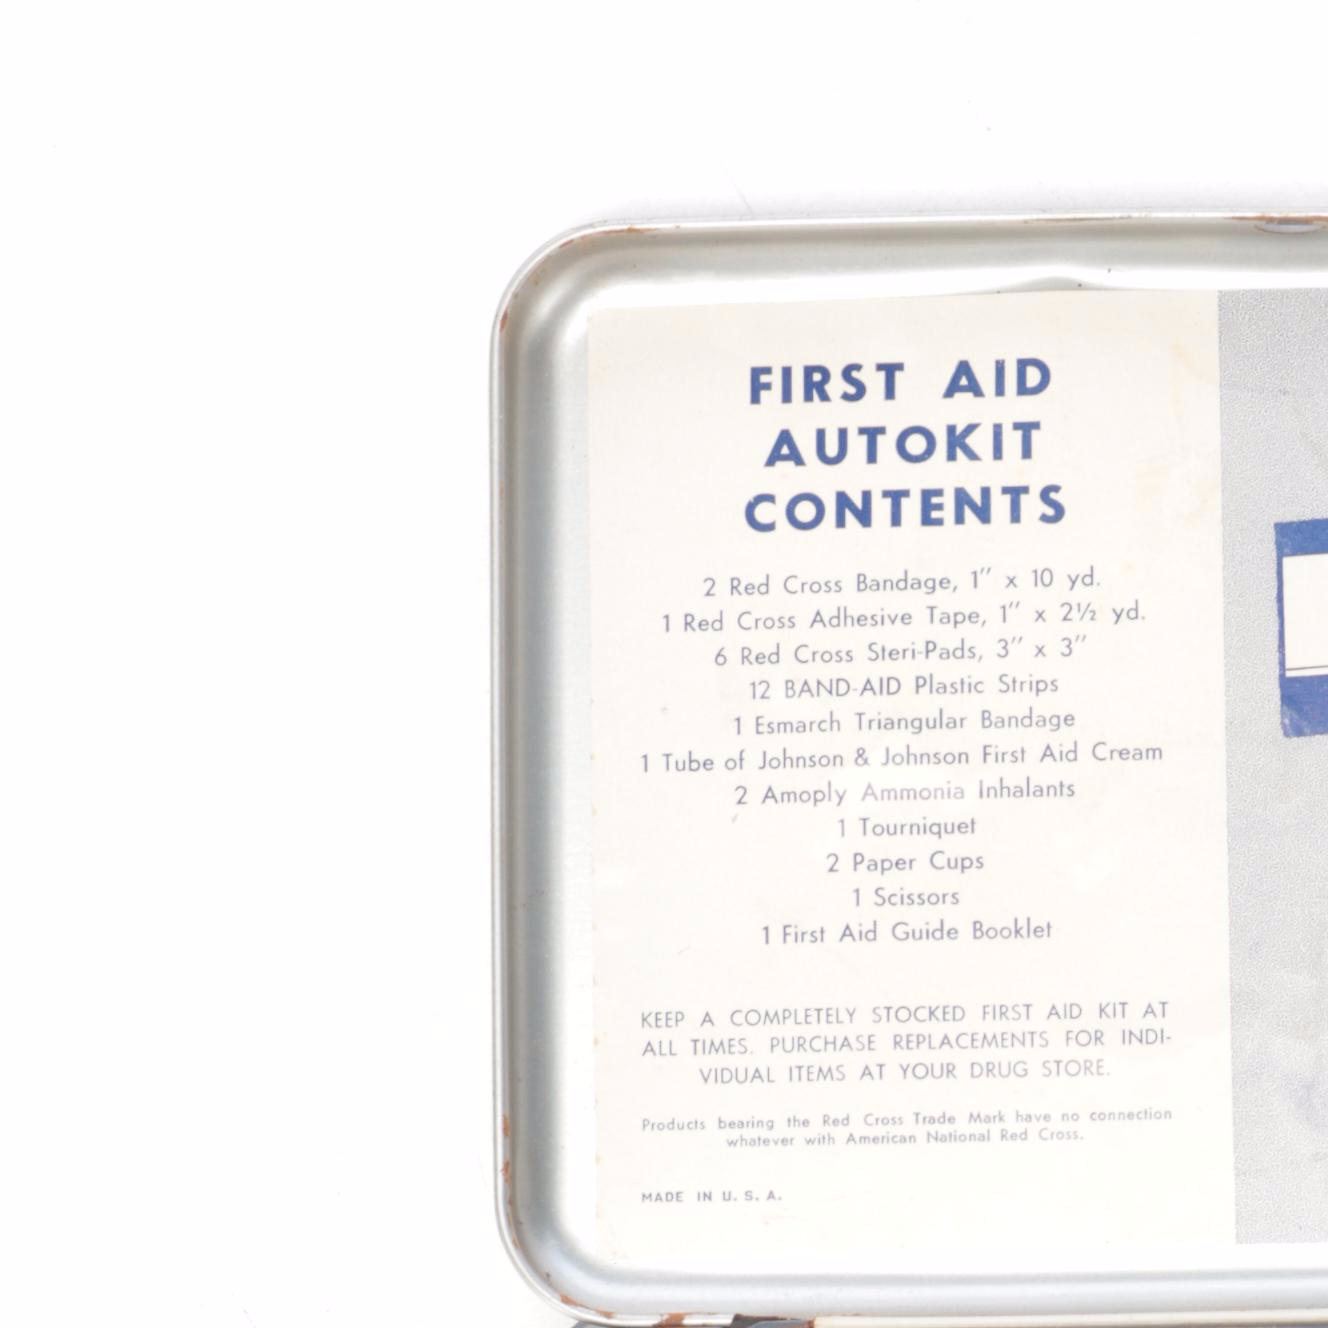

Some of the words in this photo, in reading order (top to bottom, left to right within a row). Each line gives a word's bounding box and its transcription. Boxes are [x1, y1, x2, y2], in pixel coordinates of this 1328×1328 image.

[749, 362, 905, 405] FIRST
[942, 357, 1051, 399] AID
[764, 420, 1041, 468] AUTOKIT
[744, 484, 1066, 533] CONTENTS
[730, 574, 769, 596] Red
[783, 575, 842, 594] Cross
[857, 569, 957, 595] Bandage,
[1032, 568, 1053, 587] 10
[1068, 565, 1101, 591] yd.
[684, 610, 723, 632] Red
[737, 611, 796, 631] Cross
[810, 606, 912, 628] Adhesive
[926, 606, 986, 629] Tape,
[1112, 599, 1145, 625] yd.
[741, 643, 780, 665] Red
[794, 644, 853, 664] Cross
[868, 638, 982, 662] Steri-Pads,
[750, 680, 770, 700] 12
[785, 676, 901, 698] BAND-AID
[915, 673, 983, 694] Plastic
[999, 674, 1058, 696] Strips
[755, 711, 840, 735] Esmarch
[855, 708, 966, 734] Triangular
[981, 706, 1075, 732] Bandage
[663, 750, 714, 772] Tube
[725, 749, 744, 771] of
[759, 747, 843, 770] Johnson
[882, 744, 969, 766] Johnson
[983, 745, 1025, 764] First
[1040, 741, 1077, 762] Aid
[1092, 741, 1162, 761] Cream
[762, 781, 846, 806] Amoply
[862, 783, 964, 801] Ammonia
[979, 776, 1075, 799] Inhalants
[860, 817, 976, 839] Tourniquet
[853, 852, 916, 875] Paper
[929, 850, 984, 874] Cups
[874, 887, 959, 906] Scissors
[783, 924, 825, 944] First
[839, 920, 877, 942] Aid
[892, 919, 958, 941] Guide
[973, 917, 1051, 940] Booklet
[641, 1011, 685, 1029] KEEP
[700, 1011, 715, 1027] A
[730, 1007, 856, 1027] COMPLETELY
[872, 1005, 966, 1023] STOCKED
[982, 1003, 1033, 1021] FIRST
[1046, 1002, 1083, 1020] AID
[1099, 1001, 1128, 1019] KIT
[1142, 1001, 1169, 1019] AT
[642, 1040, 677, 1057] ALL
[690, 1037, 753, 1056] TIMES.
[770, 1034, 876, 1053] PURCHASE
[893, 1031, 1049, 1051] REPLACEMENTS
[1065, 1029, 1104, 1047] FOR
[1122, 1028, 1171, 1045] INDI-
[699, 1066, 775, 1084] VIDUAL
[789, 1064, 846, 1082] ITEMS
[859, 1063, 886, 1080] AT
[899, 1062, 957, 1080] YOUR
[970, 1060, 1028, 1079] DRUG
[1042, 1059, 1111, 1077] STORE.
[642, 1117, 706, 1131] Products
[718, 1116, 774, 1131] bearing
[787, 1115, 810, 1128] the
[822, 1114, 850, 1127] Red
[864, 1113, 903, 1126] Cross
[913, 1112, 956, 1125] Trade
[968, 1110, 1005, 1124] Mark
[1016, 1110, 1051, 1123] have
[1089, 1109, 1172, 1121] connection
[726, 1134, 794, 1147] whatever
[804, 1132, 835, 1145] with
[846, 1132, 917, 1145] American
[926, 1129, 990, 1143] National
[1000, 1128, 1028, 1141] Red
[1038, 1127, 1083, 1141] Cross.
[641, 1191, 683, 1203] MADE
[697, 1191, 712, 1202] IN
